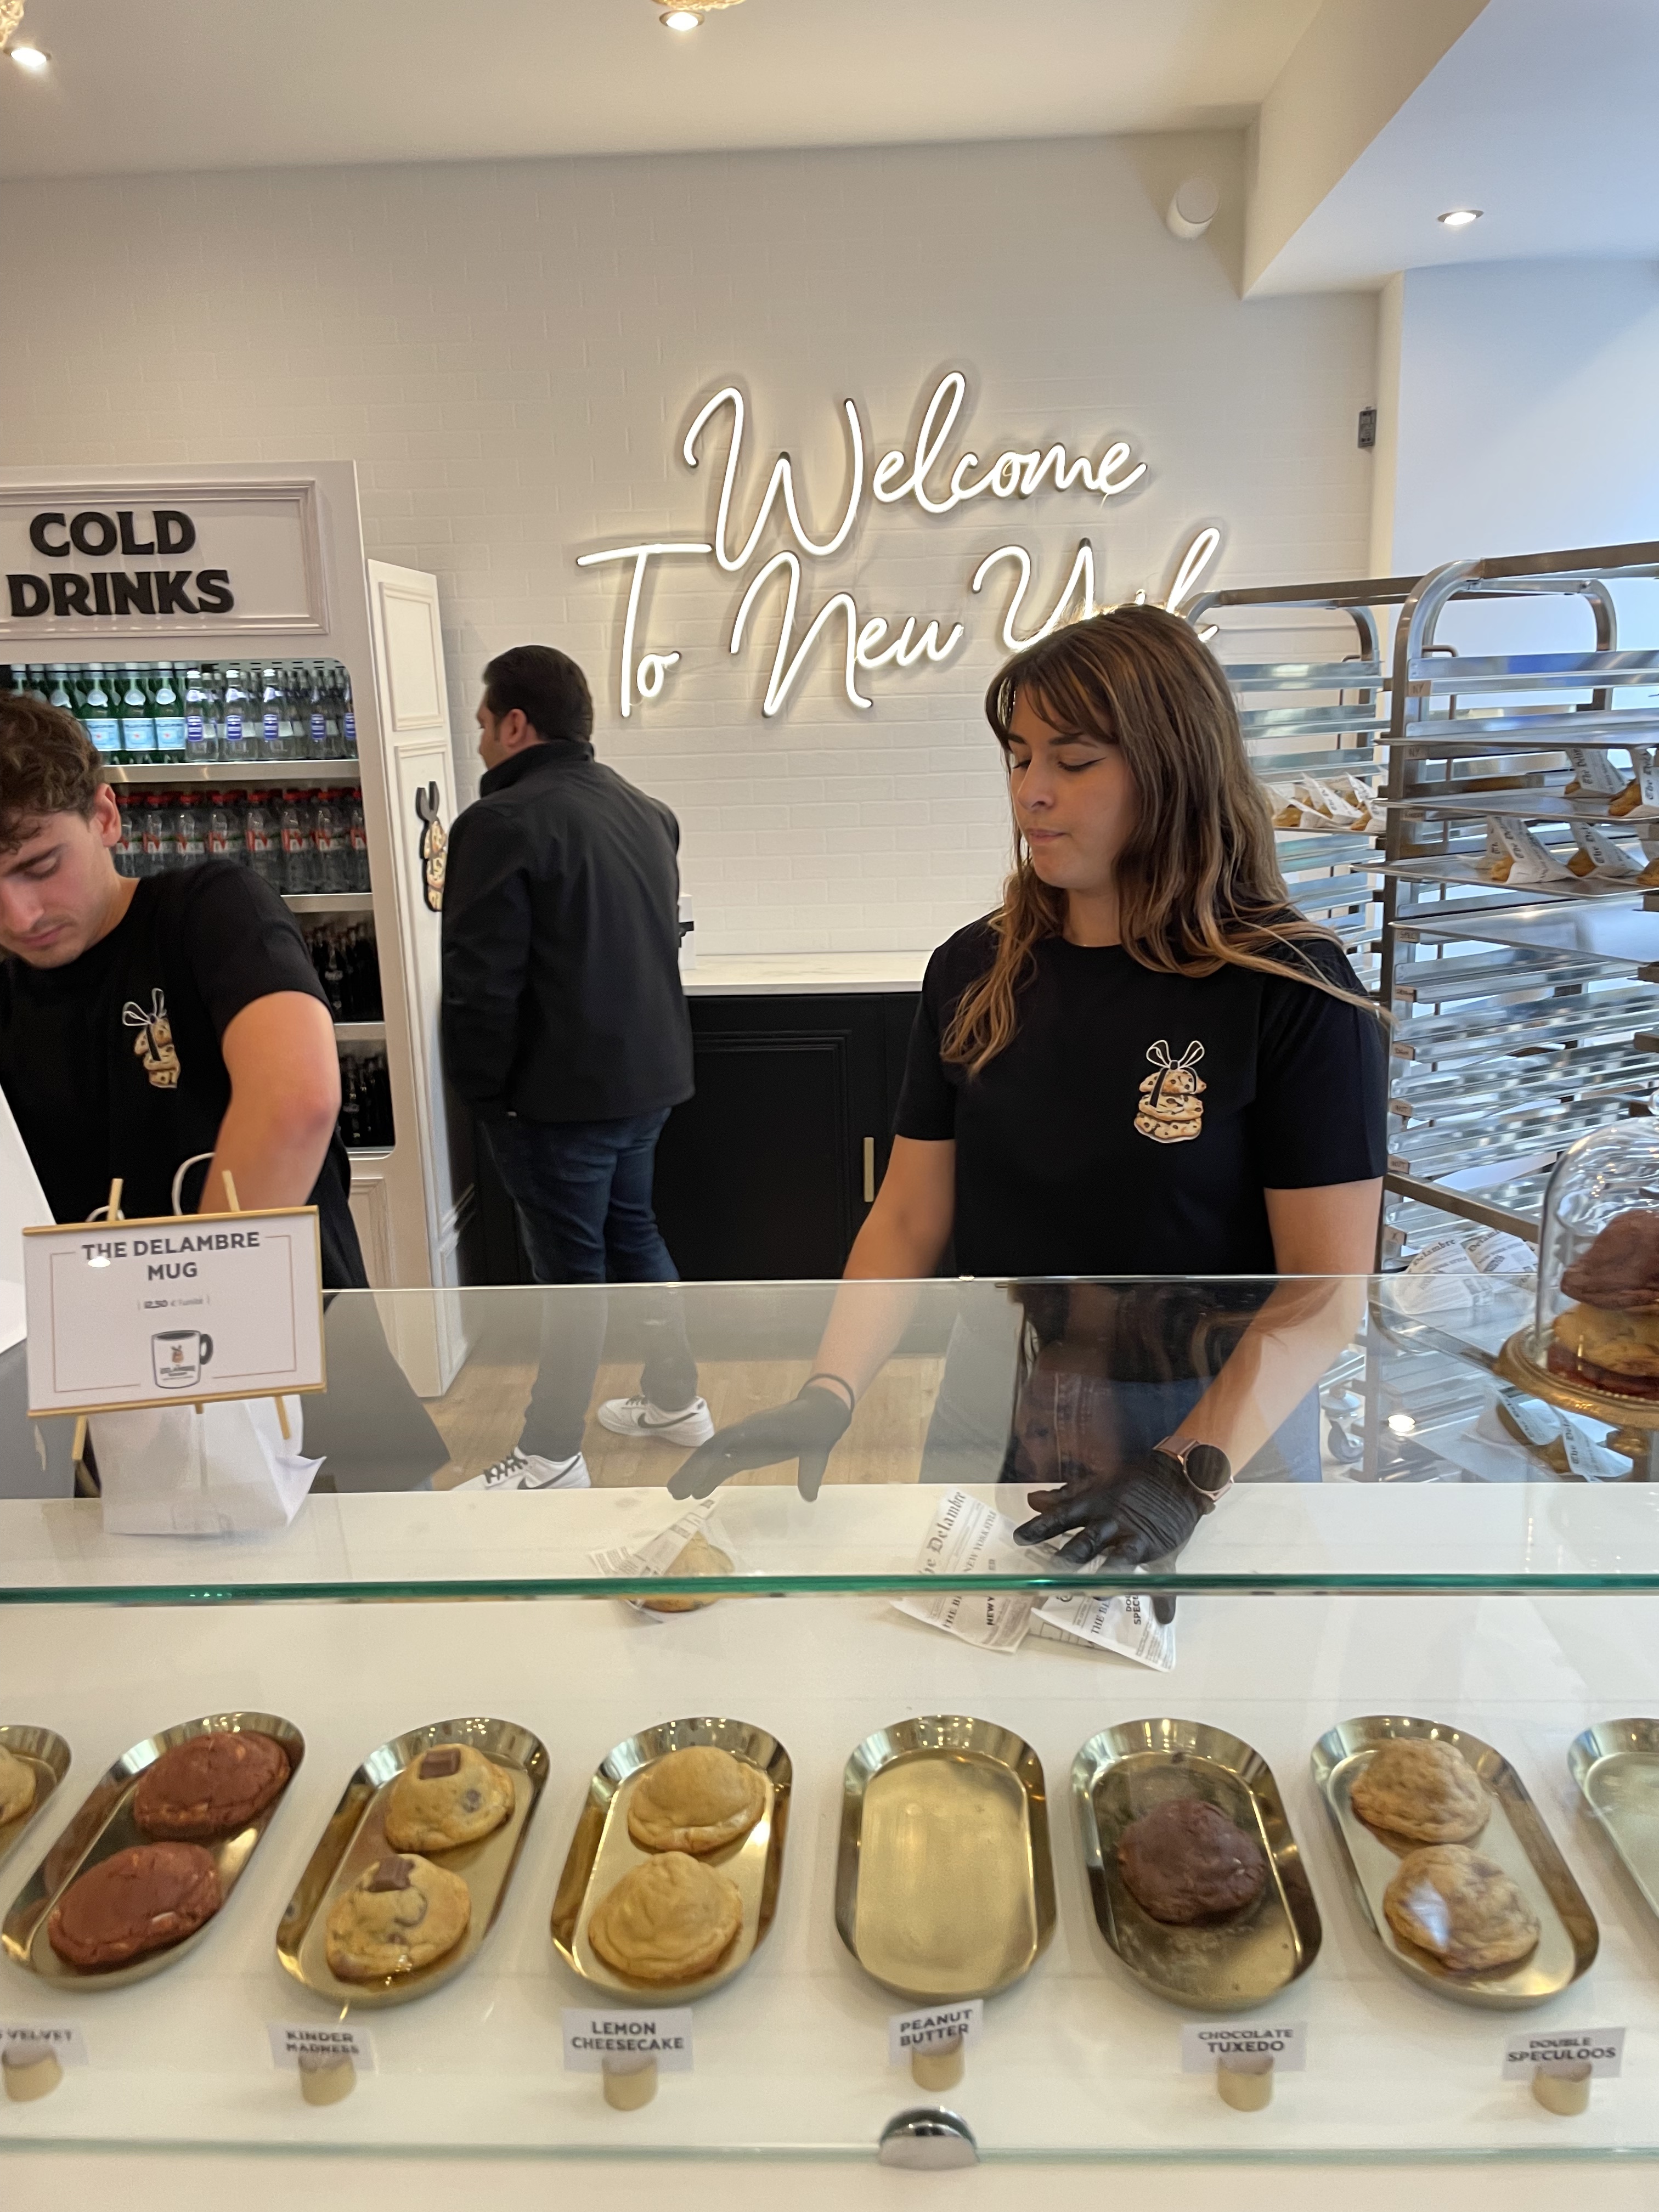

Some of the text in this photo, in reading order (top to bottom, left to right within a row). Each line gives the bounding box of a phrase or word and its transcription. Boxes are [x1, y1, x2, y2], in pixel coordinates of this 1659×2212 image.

[683, 371, 1147, 572] Welcome
[30, 510, 196, 557] COLD
[5, 568, 235, 617] DRINKS
[576, 542, 712, 718] To
[731, 551, 964, 719] New
[82, 1231, 260, 1261] THE DELAMBRE
[147, 1262, 198, 1281] MUG
[926, 1491, 966, 1555] Delambre
[1090, 1616, 1105, 1634] THE
[591, 2021, 656, 2035] LEMON
[900, 2009, 973, 2033] PEANUT
[286, 2030, 354, 2042] KINDER
[572, 2036, 684, 2051] CHEESECAKE
[900, 2023, 969, 2046] BUTTER
[1198, 2029, 1294, 2040] CHOCOLATE
[1530, 2037, 1592, 2049] DOUBLE
[286, 2043, 360, 2054] MADNESS
[1208, 2040, 1285, 2052] TUXEDO
[1507, 2047, 1616, 2062] SPECULOOS
